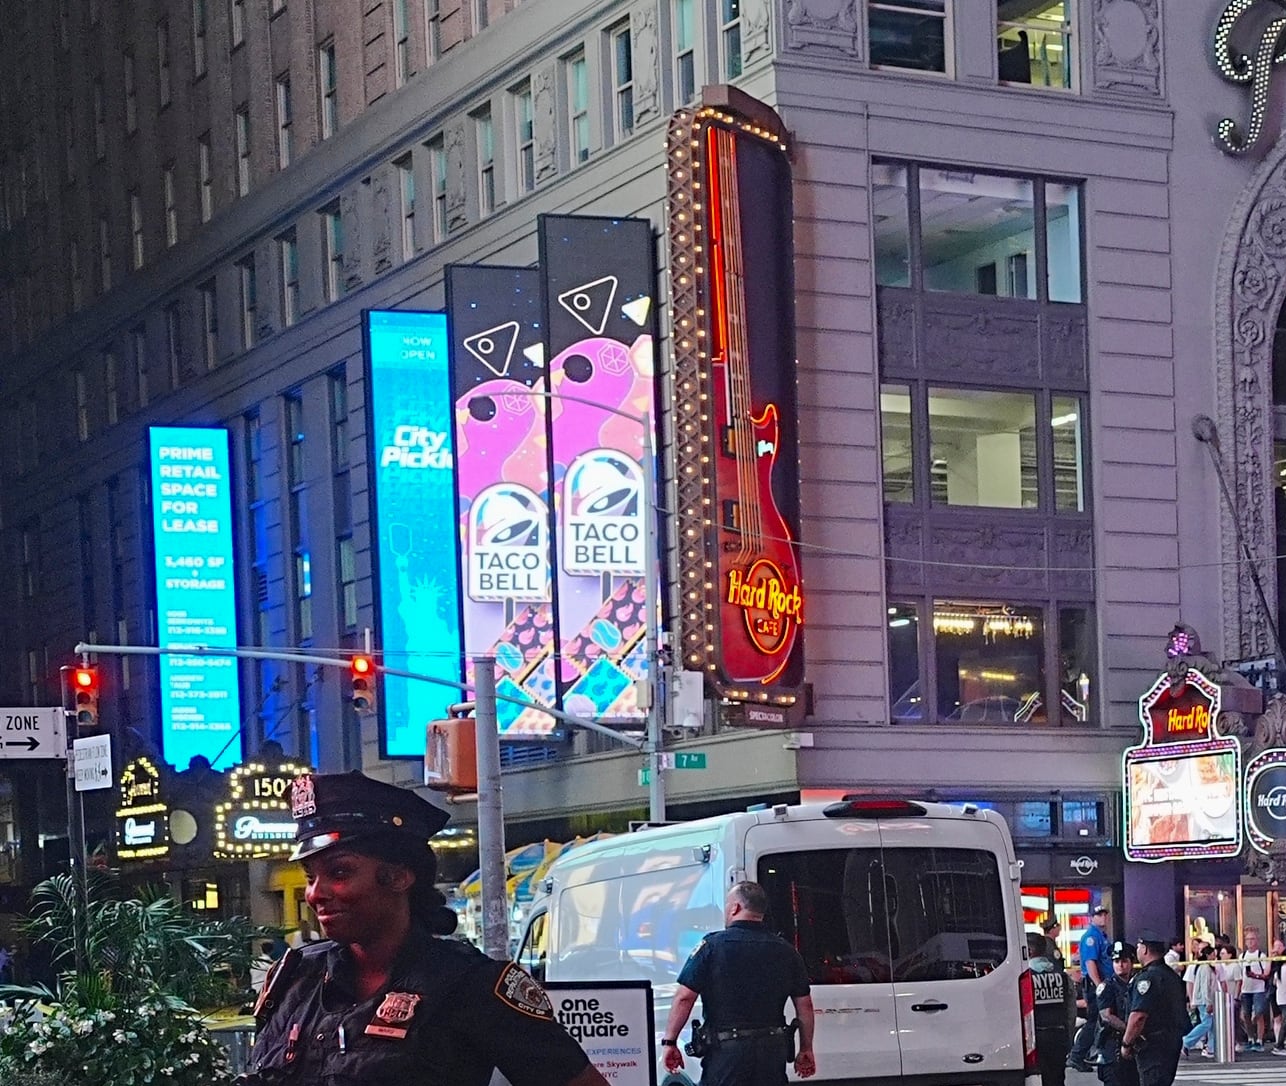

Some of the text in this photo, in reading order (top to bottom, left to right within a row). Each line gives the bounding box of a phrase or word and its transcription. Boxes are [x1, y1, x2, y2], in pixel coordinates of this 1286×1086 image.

[393, 424, 447, 453] City
[159, 446, 213, 460] PRIME
[159, 464, 221, 479] RETAIL
[160, 483, 217, 497] SPACE
[161, 500, 198, 514] FOR
[162, 519, 219, 533] LEASE
[569, 522, 639, 541] TACO
[474, 552, 540, 570] TACO
[575, 545, 638, 564] BELL
[479, 573, 539, 590] BELL
[728, 569, 802, 624] Hard Rock
[6, 715, 40, 730] ZONE
[1168, 705, 1209, 733] Hard Ro
[681, 755, 688, 767] 7
[1257, 793, 1280, 807] Hard
[1032, 972, 1063, 988] NYPD
[1034, 987, 1064, 1000] POLICE
[518, 1002, 534, 1012] CITY
[561, 998, 600, 1012] one
[557, 1009, 614, 1024] times
[586, 1047, 642, 1056] EXPERIENCES
[606, 1061, 638, 1069] Skywalk
